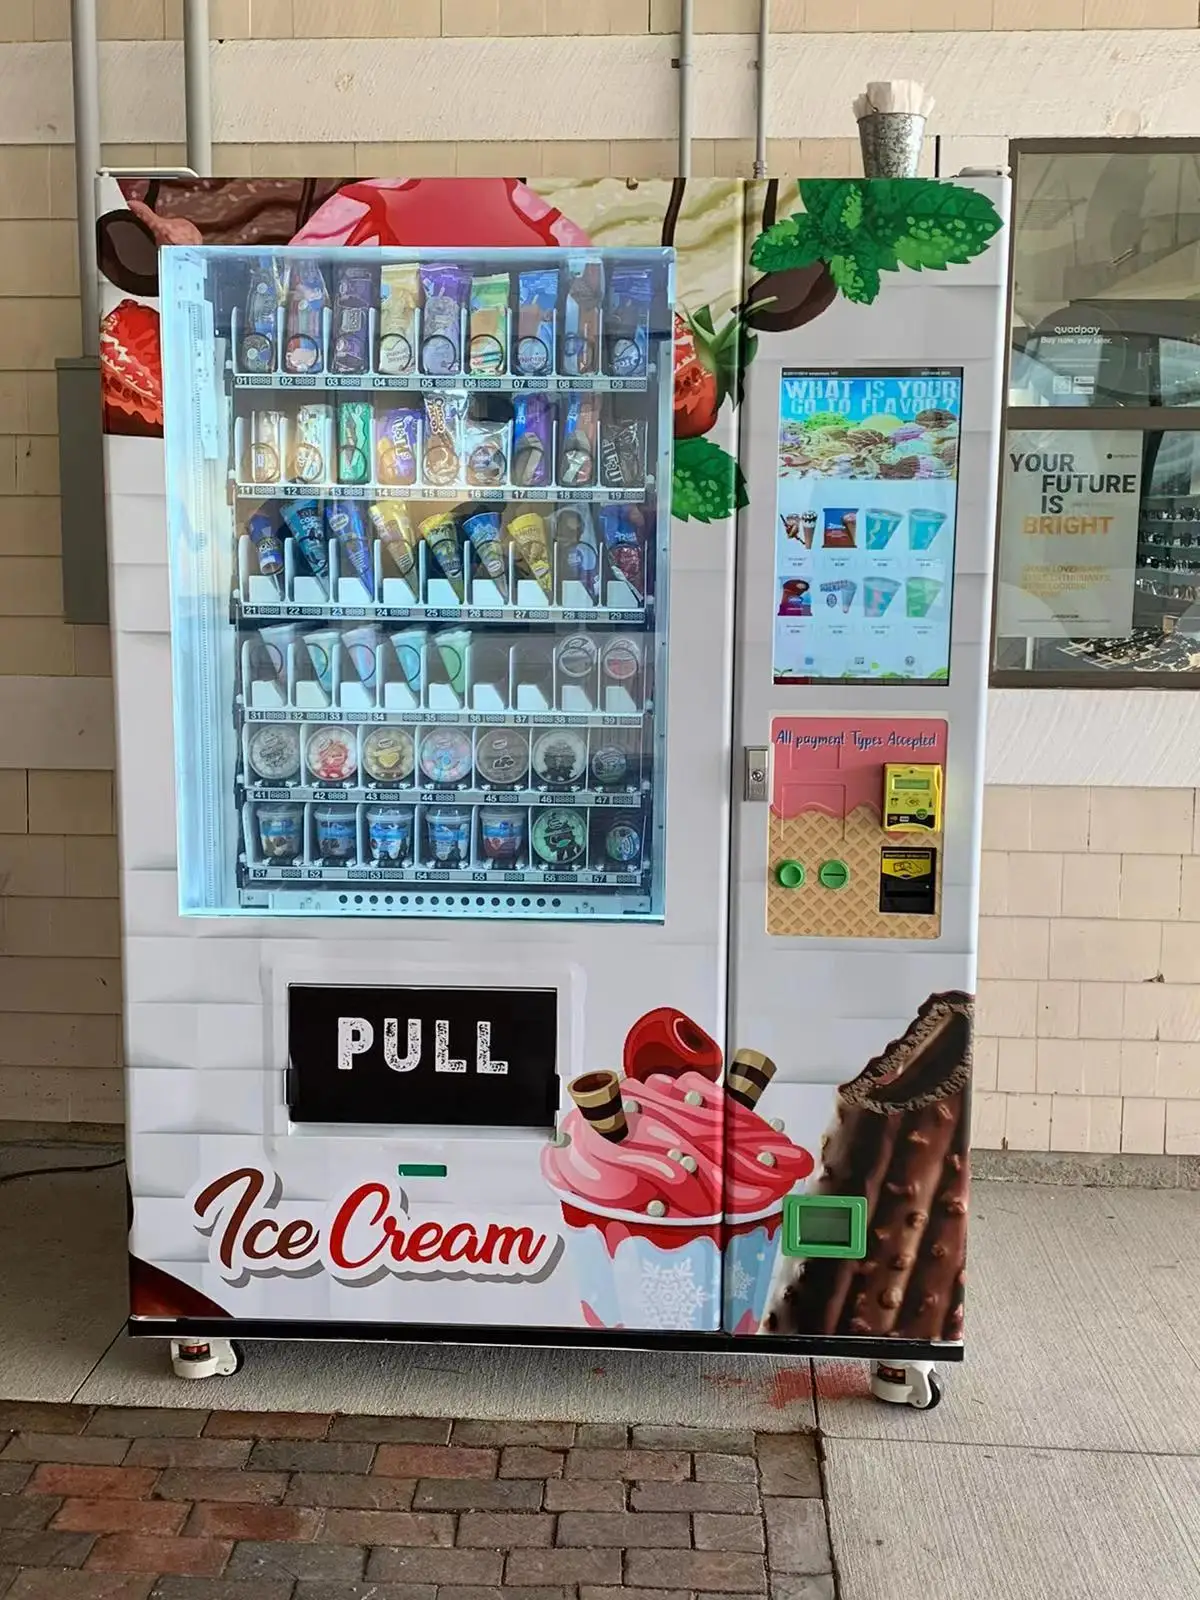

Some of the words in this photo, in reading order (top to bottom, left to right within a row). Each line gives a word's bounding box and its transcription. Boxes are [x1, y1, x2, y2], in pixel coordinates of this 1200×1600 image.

[1054, 325, 1100, 335] quadpay
[421, 379, 433, 387] 05
[513, 380, 525, 388] 07
[785, 380, 854, 399] WHAT
[866, 381, 885, 399] IS
[898, 380, 957, 399] YOUR
[791, 399, 815, 414] GO
[829, 399, 850, 414] TO
[1009, 453, 1075, 472] YOUR
[1042, 474, 1136, 493] FUTURE
[559, 491, 570, 499] 18
[1041, 495, 1063, 514] IS
[1023, 516, 1115, 535] BRIGHT
[469, 610, 481, 618] 26
[516, 611, 527, 619] 27
[250, 712, 261, 720] 31
[292, 712, 304, 720] 32
[776, 730, 791, 745] All
[796, 731, 844, 749] payment
[851, 731, 883, 750] Types
[888, 731, 938, 751] Accepted
[255, 791, 266, 799] 41
[314, 792, 325, 800] 42
[366, 793, 377, 801] 43
[309, 870, 320, 878] 52
[370, 871, 381, 879] 53
[416, 872, 428, 880] 54
[593, 874, 605, 882] 57
[337, 1017, 509, 1075] PULL
[193, 1167, 320, 1269] Ice
[329, 1182, 547, 1269] Cream
